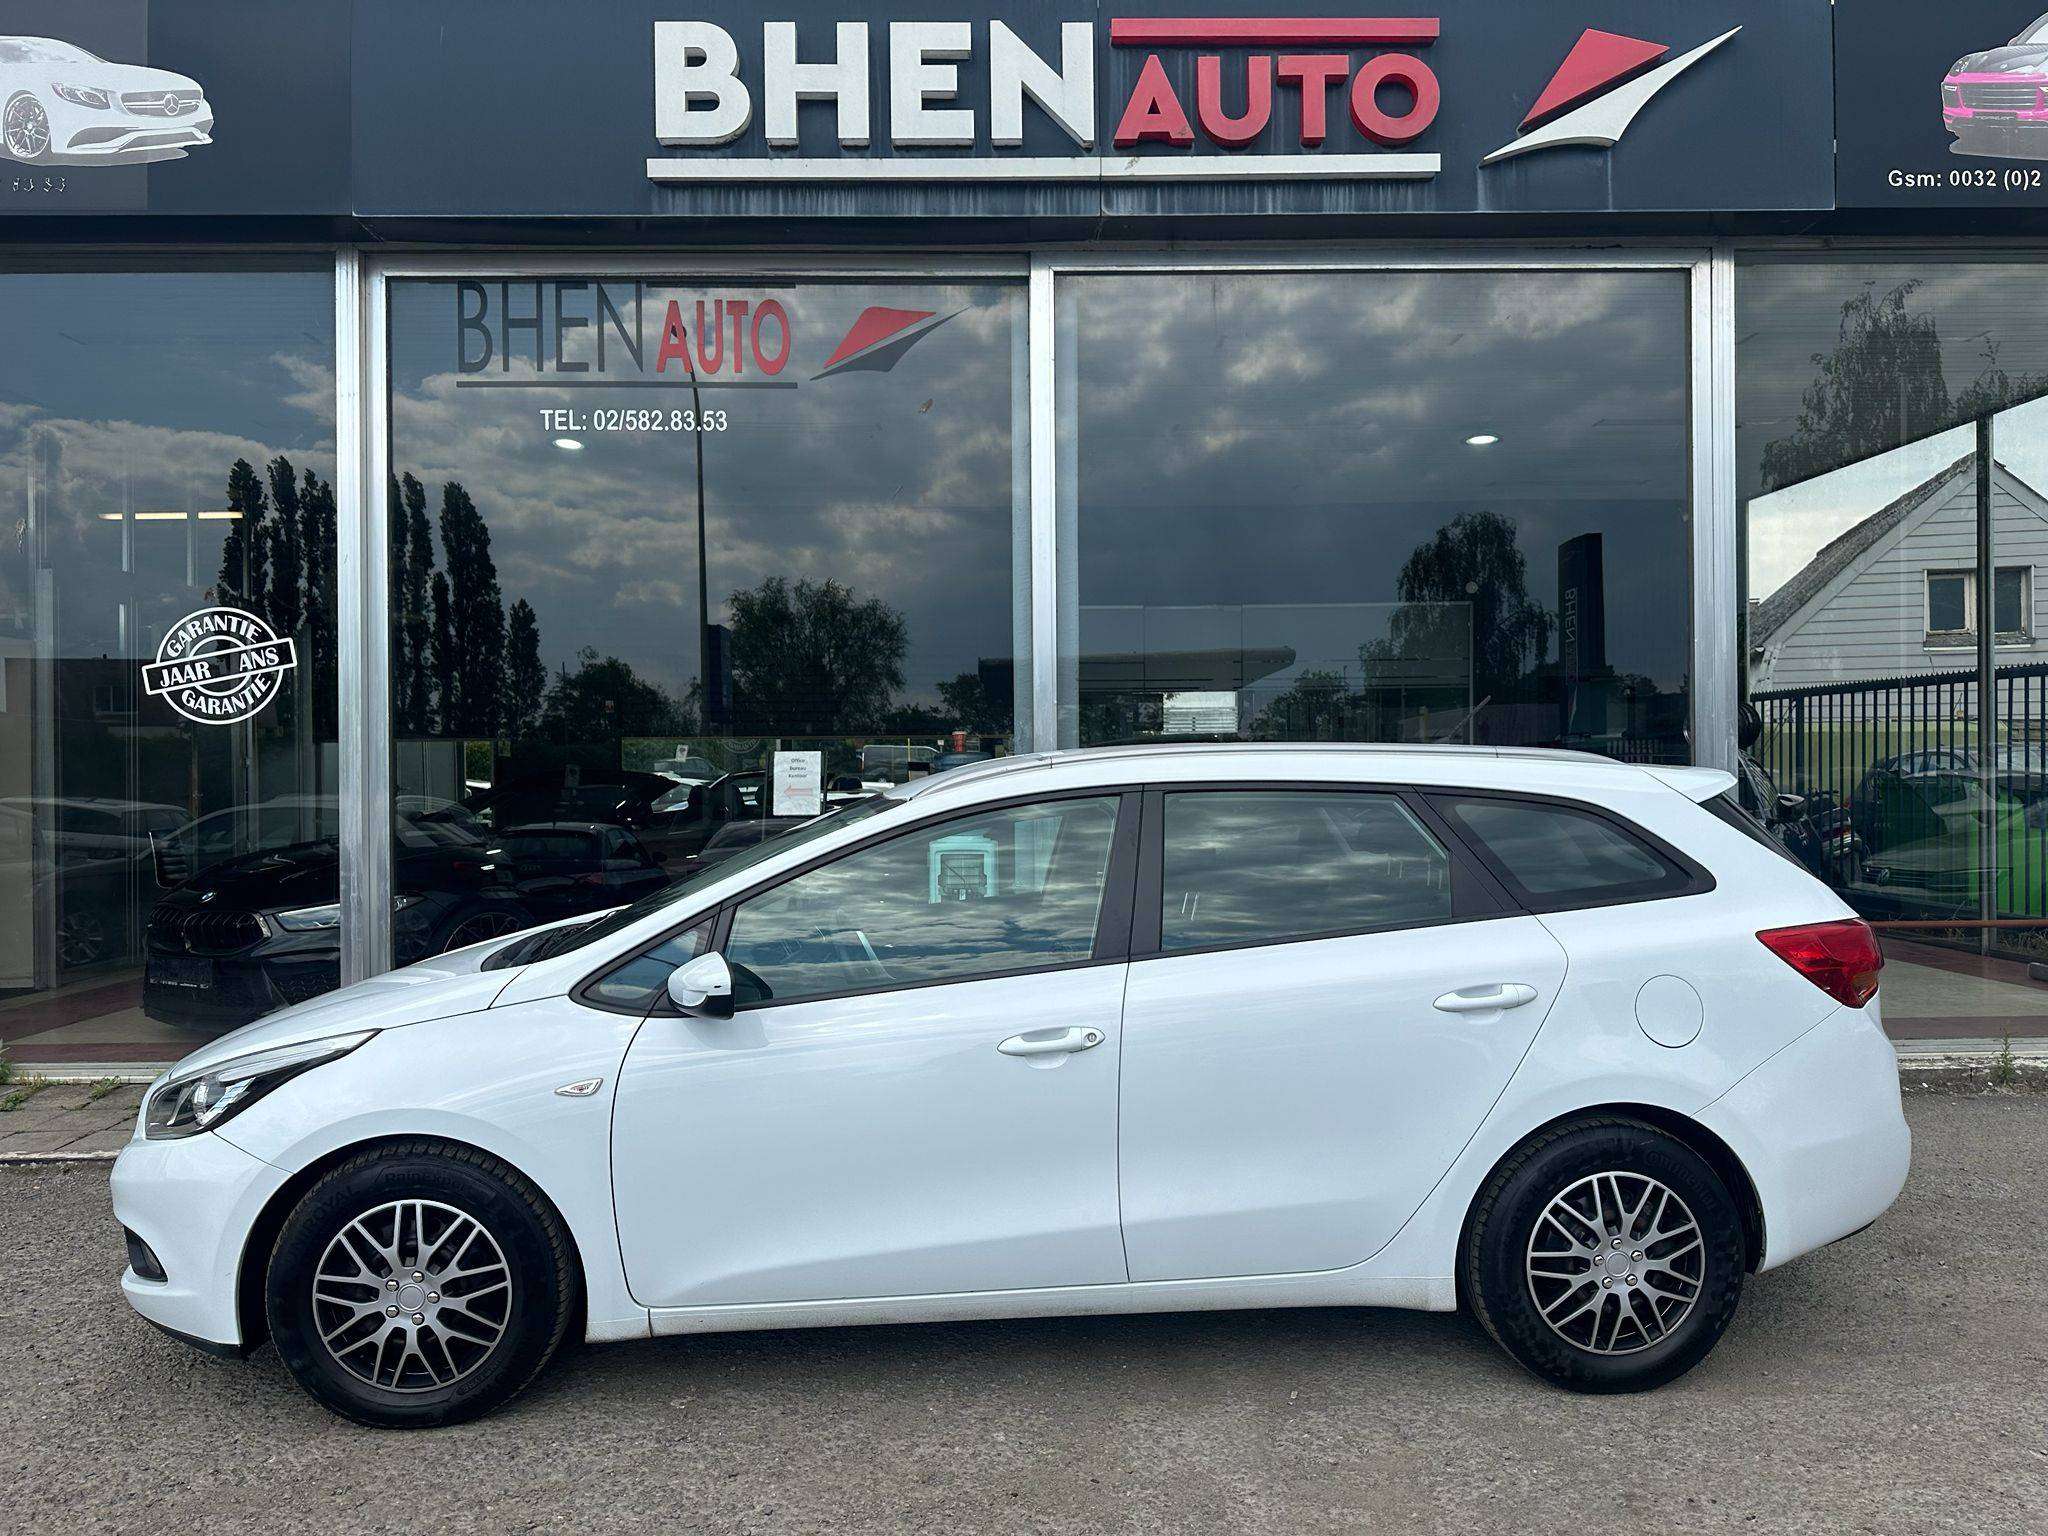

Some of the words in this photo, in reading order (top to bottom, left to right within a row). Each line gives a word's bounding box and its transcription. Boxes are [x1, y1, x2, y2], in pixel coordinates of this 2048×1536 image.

[653, 20, 1095, 147] BHEN
[1113, 52, 1440, 147] AUTO
[1888, 169, 1942, 188] Gsm:
[1949, 169, 1998, 187] 0032
[2004, 169, 2042, 191] (0)2
[457, 280, 644, 373] BHEN
[656, 299, 792, 376] AUTO
[540, 409, 587, 431] TEL:
[593, 409, 728, 432] 02/582.83.53
[166, 614, 262, 658] GARANTIE
[160, 660, 212, 688] JAAR
[239, 646, 280, 672] ANS
[181, 673, 271, 715] GARANTIE
